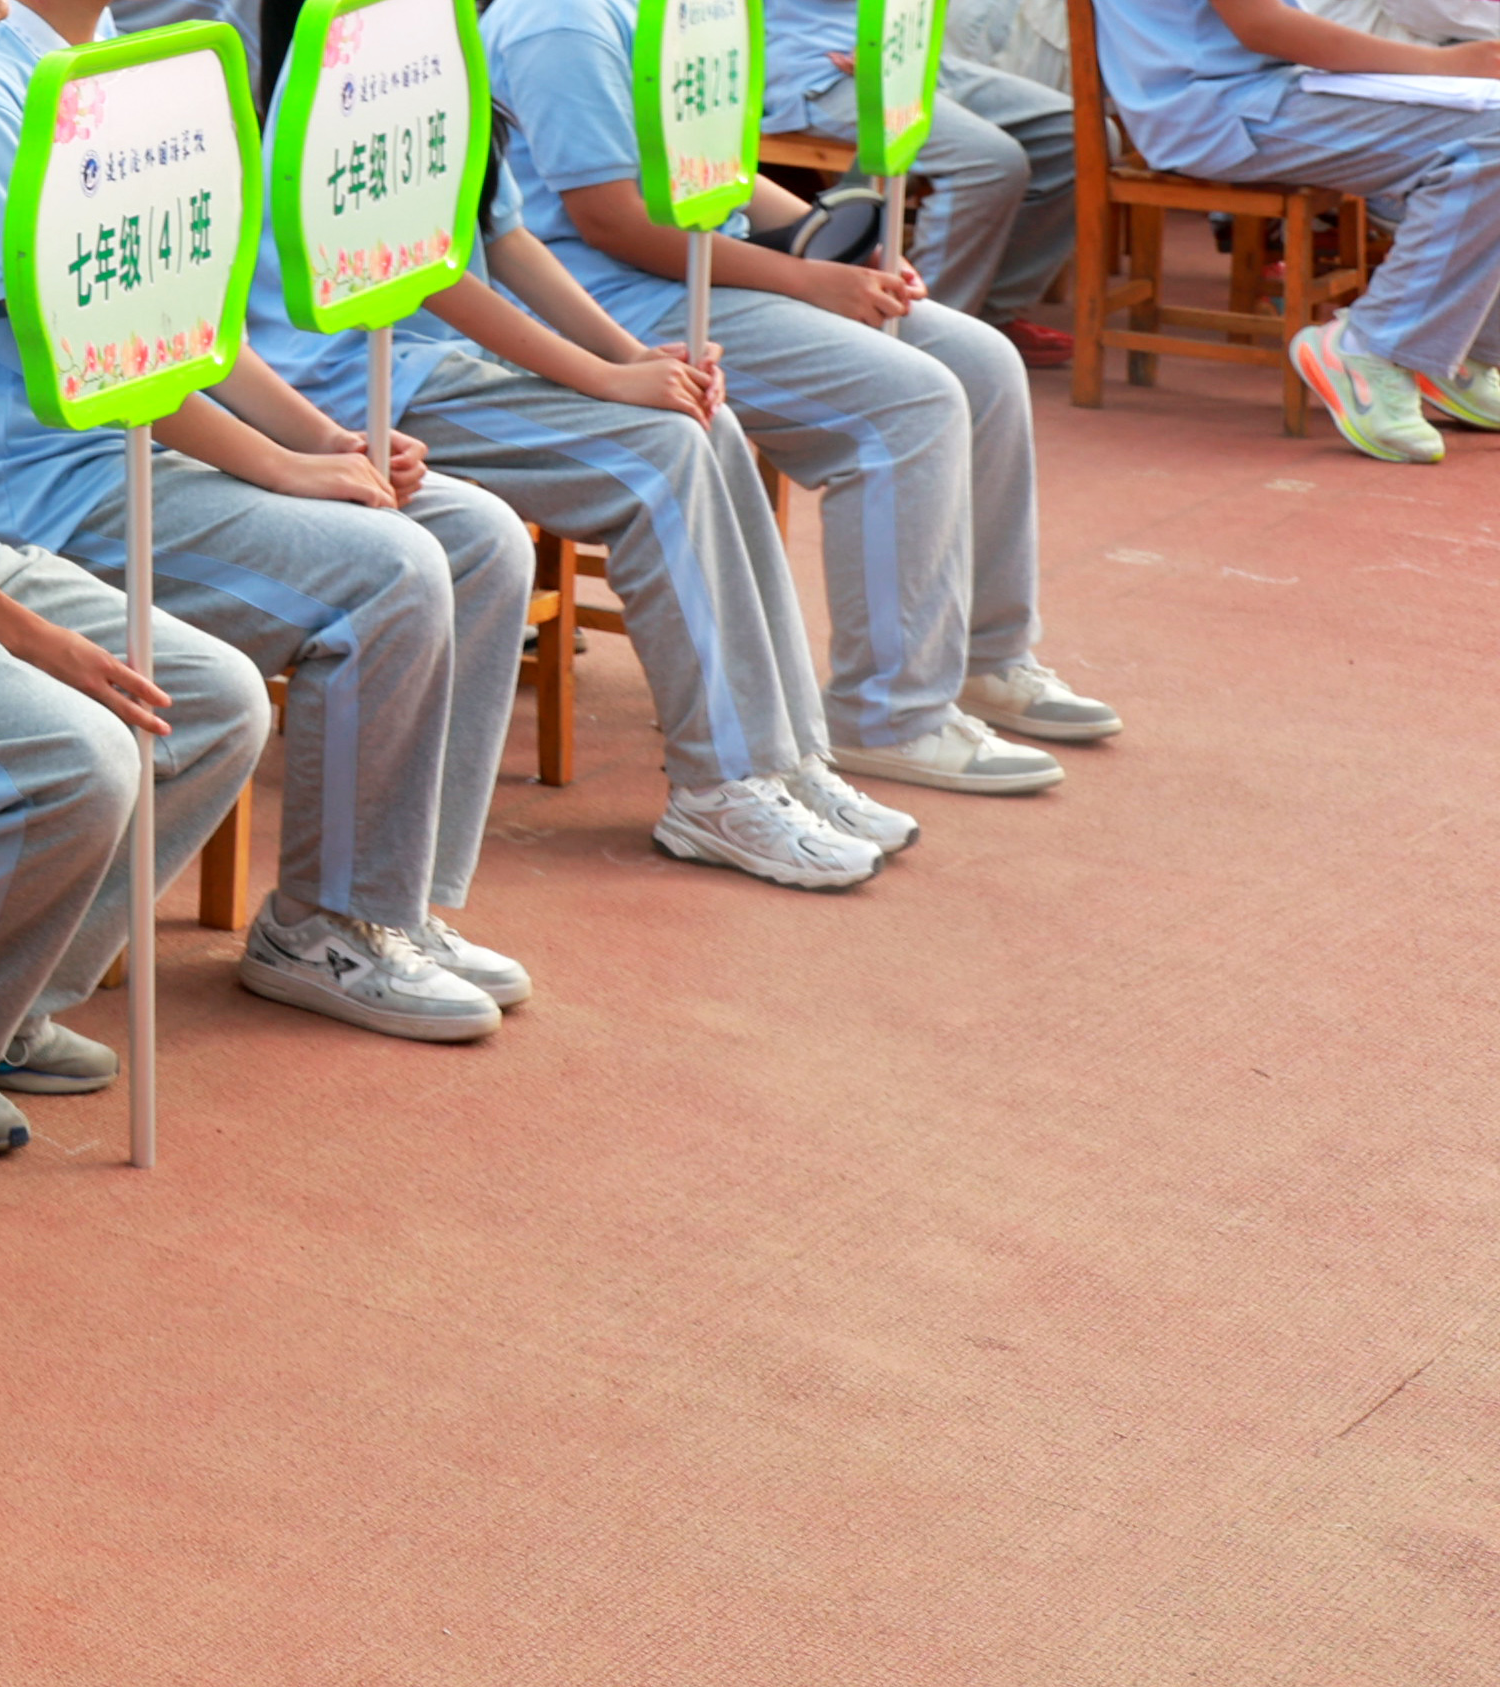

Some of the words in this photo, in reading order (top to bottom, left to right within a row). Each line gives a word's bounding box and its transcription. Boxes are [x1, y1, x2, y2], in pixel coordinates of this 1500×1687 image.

[328, 109, 447, 216] 七年级(3)班
[69, 188, 212, 307] 七年级(4)班
